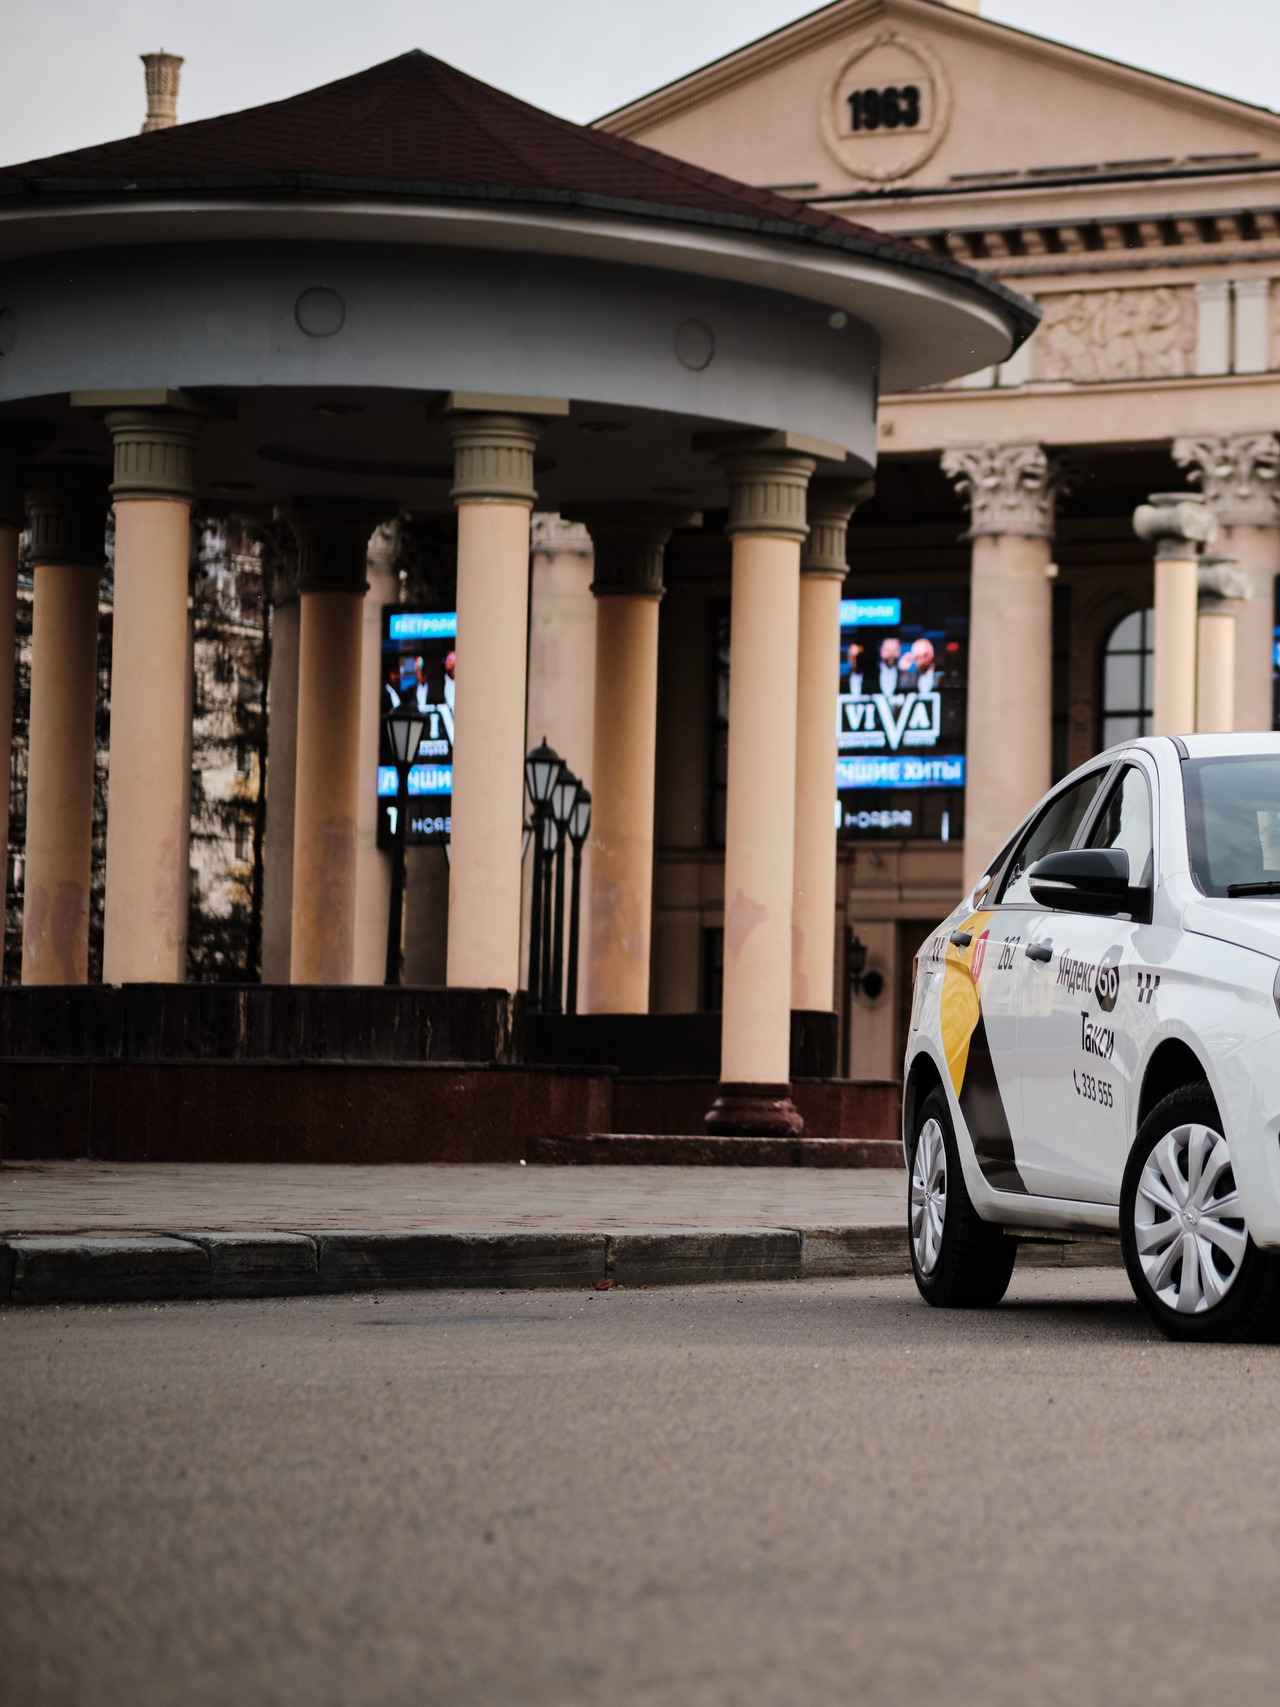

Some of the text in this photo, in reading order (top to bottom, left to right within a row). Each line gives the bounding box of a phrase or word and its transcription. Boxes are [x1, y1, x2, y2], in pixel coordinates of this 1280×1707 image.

[847, 85, 920, 132] 1963
[845, 693, 930, 750] VIVA
[383, 769, 452, 791] ЛЧШИ
[838, 760, 962, 782] ЧШИЕ ХИТЫ
[412, 816, 451, 834] НОЯБ
[997, 935, 1021, 971] 262
[1056, 948, 1096, 995] Яндекс
[1080, 1011, 1114, 1060] Такси
[1081, 1072, 1113, 1108] 333 555
